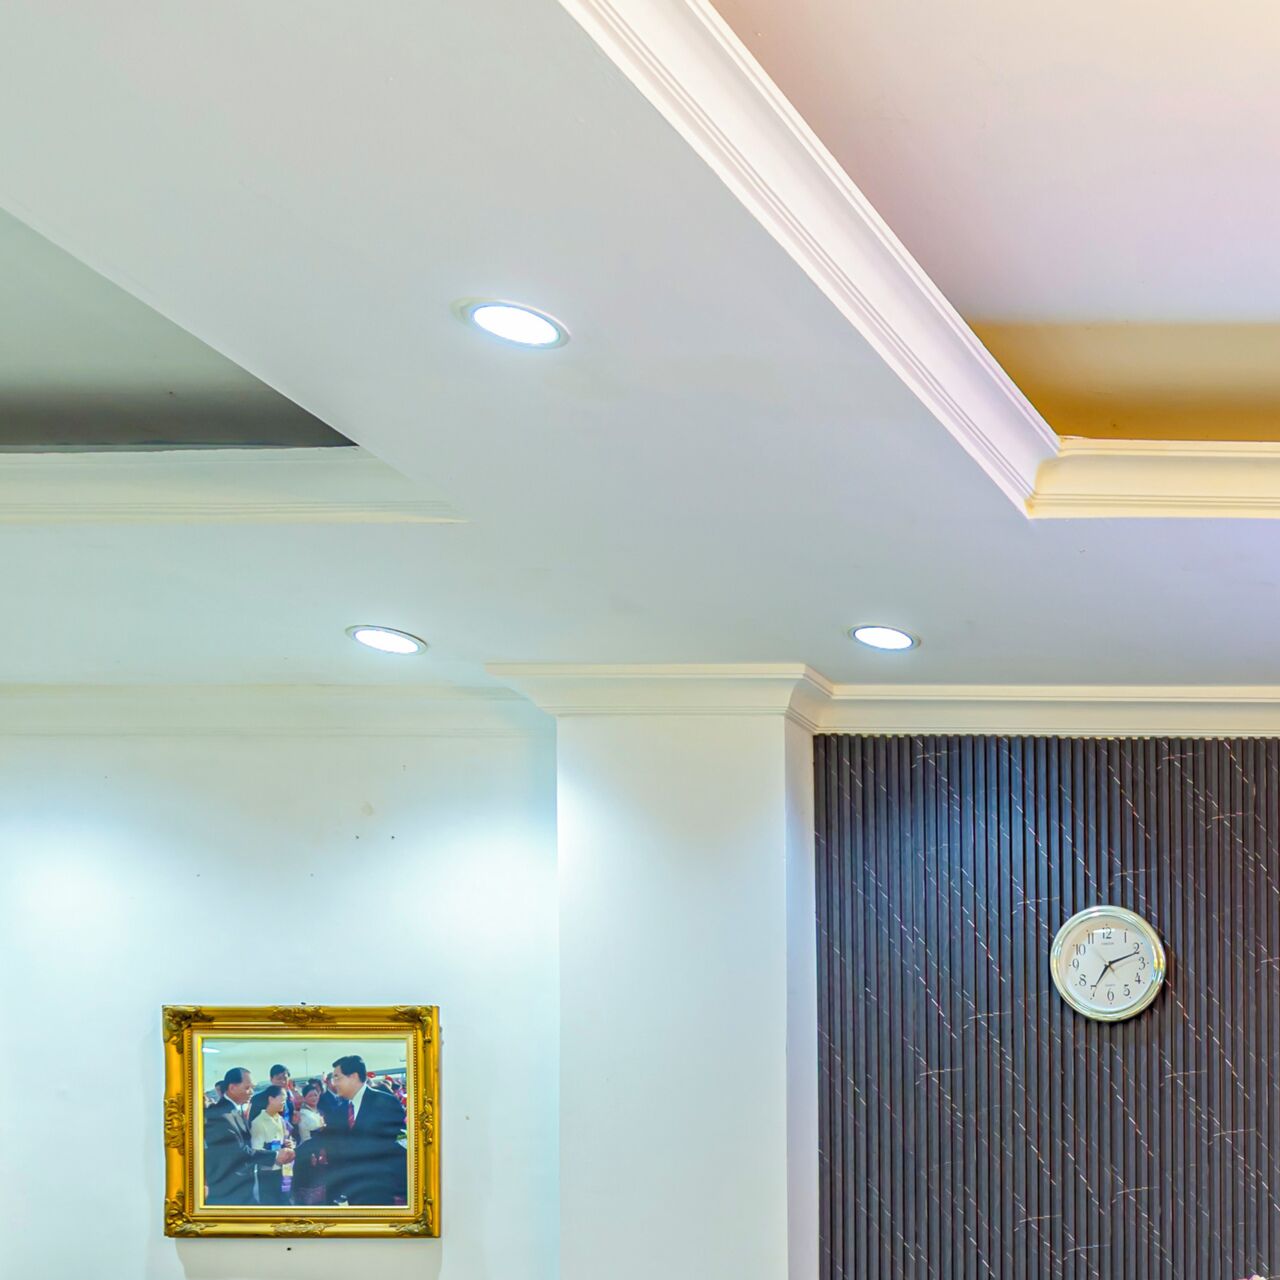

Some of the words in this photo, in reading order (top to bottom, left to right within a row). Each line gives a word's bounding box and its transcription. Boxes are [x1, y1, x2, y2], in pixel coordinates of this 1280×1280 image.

[1088, 933, 1094, 944] 11
[1102, 927, 1112, 939] 12
[1124, 932, 1126, 942] 1
[1076, 944, 1085, 955] 10
[1134, 942, 1140, 954] 2
[1072, 959, 1079, 970] 9
[1139, 957, 1145, 970] 3
[1079, 974, 1086, 986] 8
[1135, 973, 1141, 984] 4
[1107, 988, 1114, 1000] 6
[1124, 984, 1130, 996] 5
